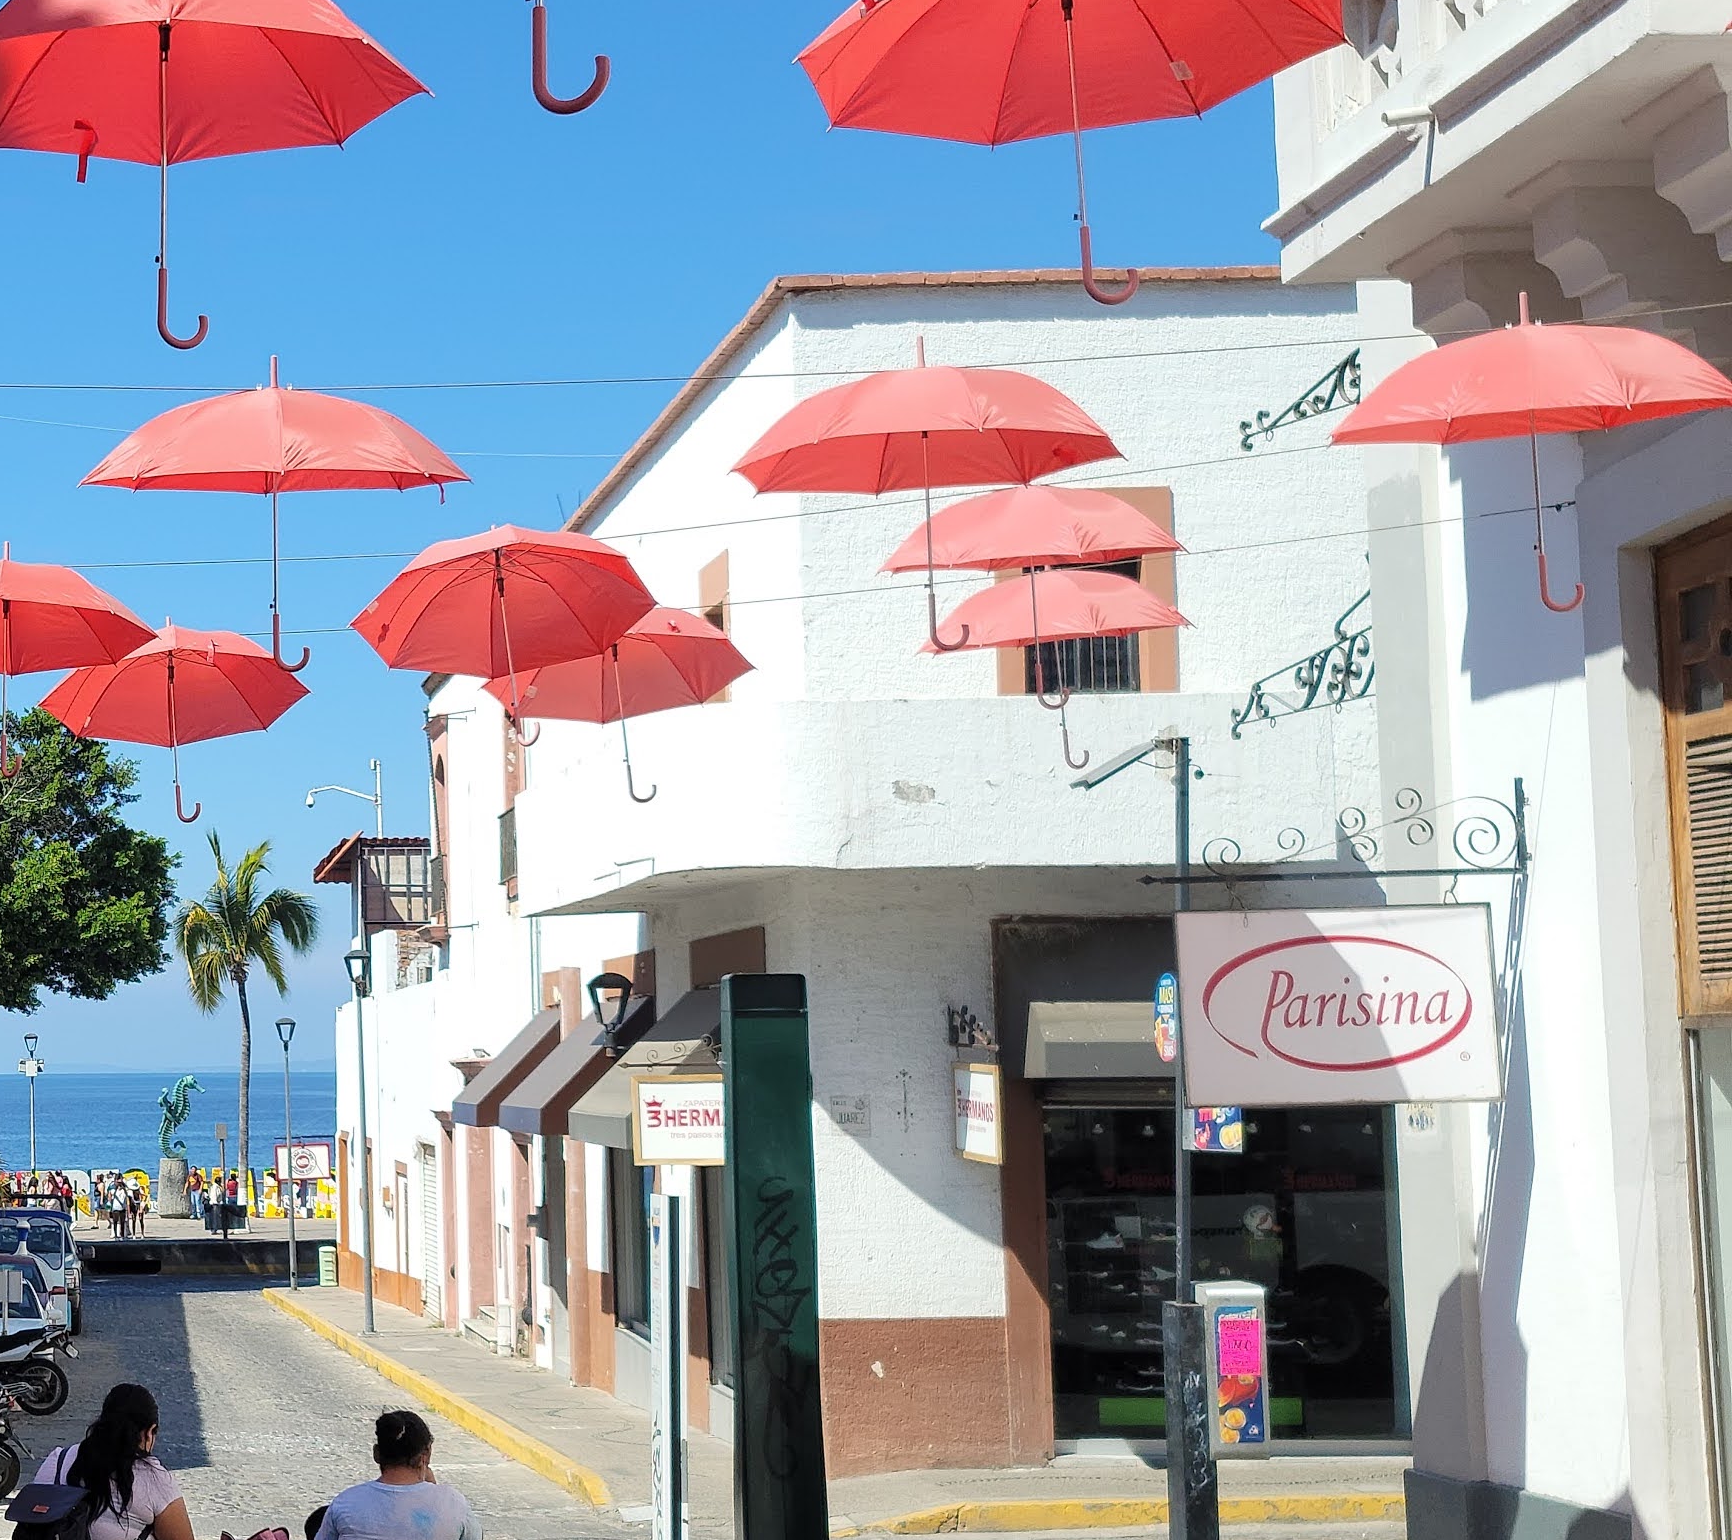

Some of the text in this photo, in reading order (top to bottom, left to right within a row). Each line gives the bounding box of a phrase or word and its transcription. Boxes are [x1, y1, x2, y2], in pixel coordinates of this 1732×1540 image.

[1261, 969, 1453, 1030] Parisina
[683, 1099, 723, 1107] ZAPATER
[836, 1111, 866, 1125] JUAREZ
